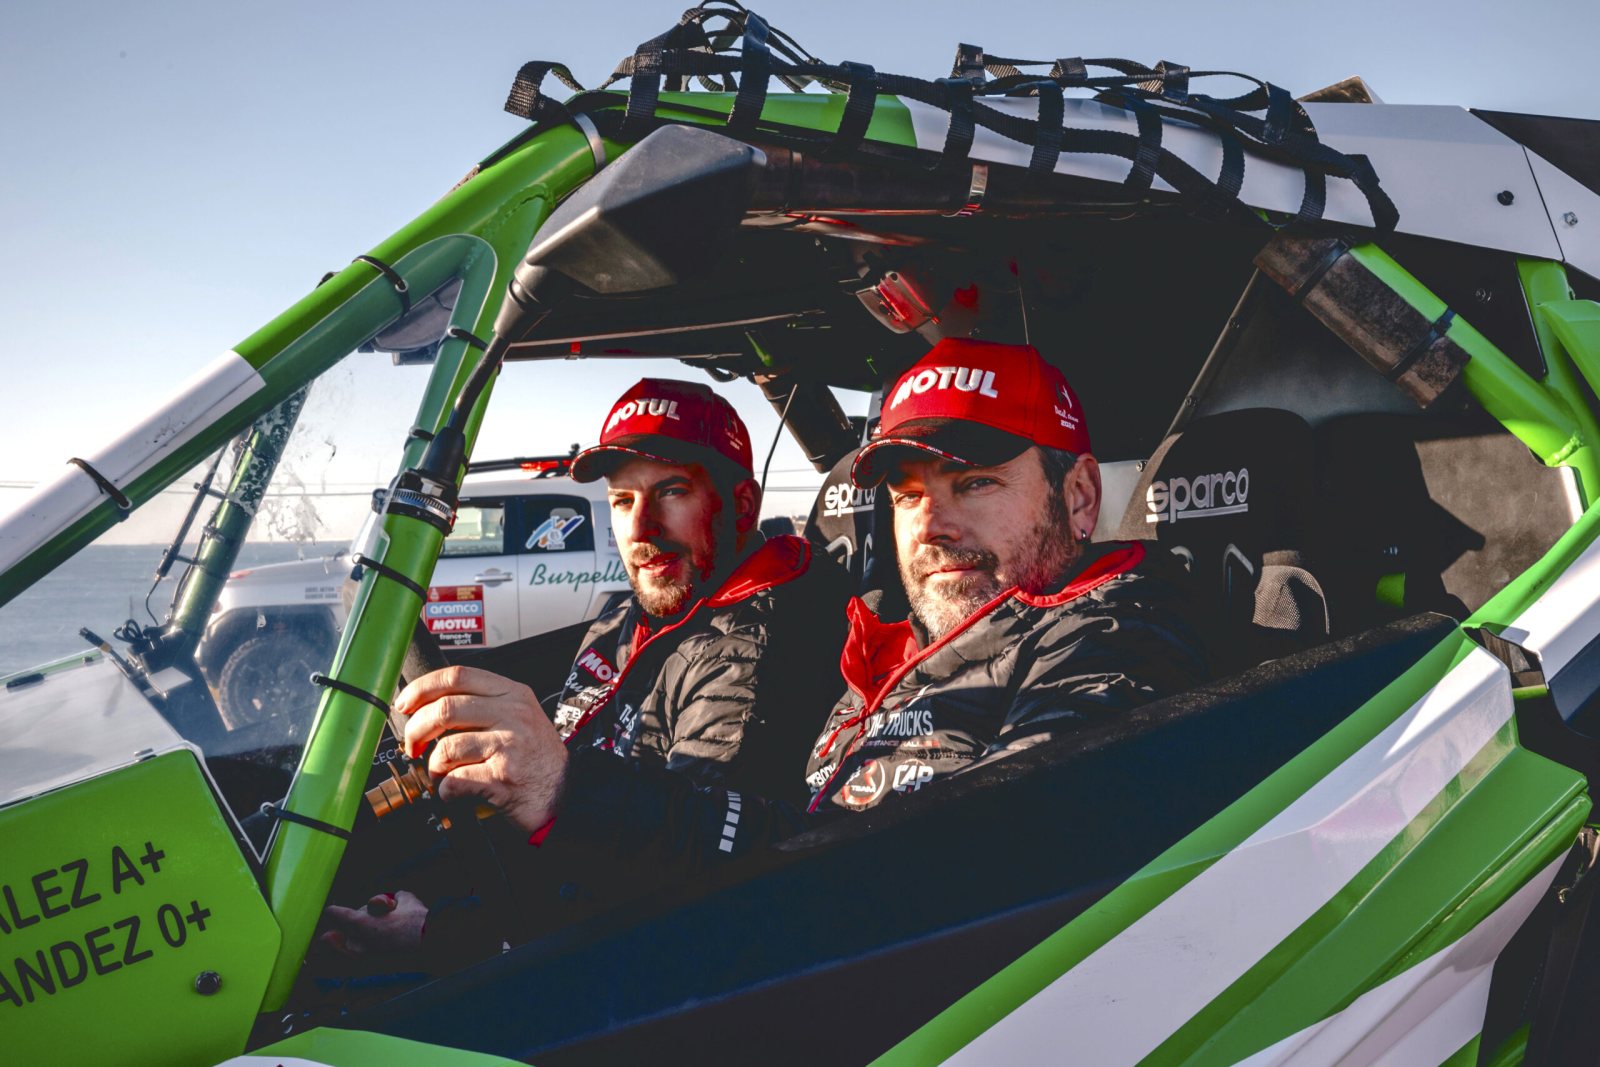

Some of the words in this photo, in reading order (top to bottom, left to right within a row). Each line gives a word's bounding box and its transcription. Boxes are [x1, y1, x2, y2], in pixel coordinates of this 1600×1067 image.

[891, 366, 998, 411] MOTUL
[605, 398, 680, 434] MOTUL
[1146, 467, 1250, 524] sparco
[430, 603, 479, 615] aramco
[432, 618, 478, 631] MOTUL
[111, 840, 166, 895] A+
